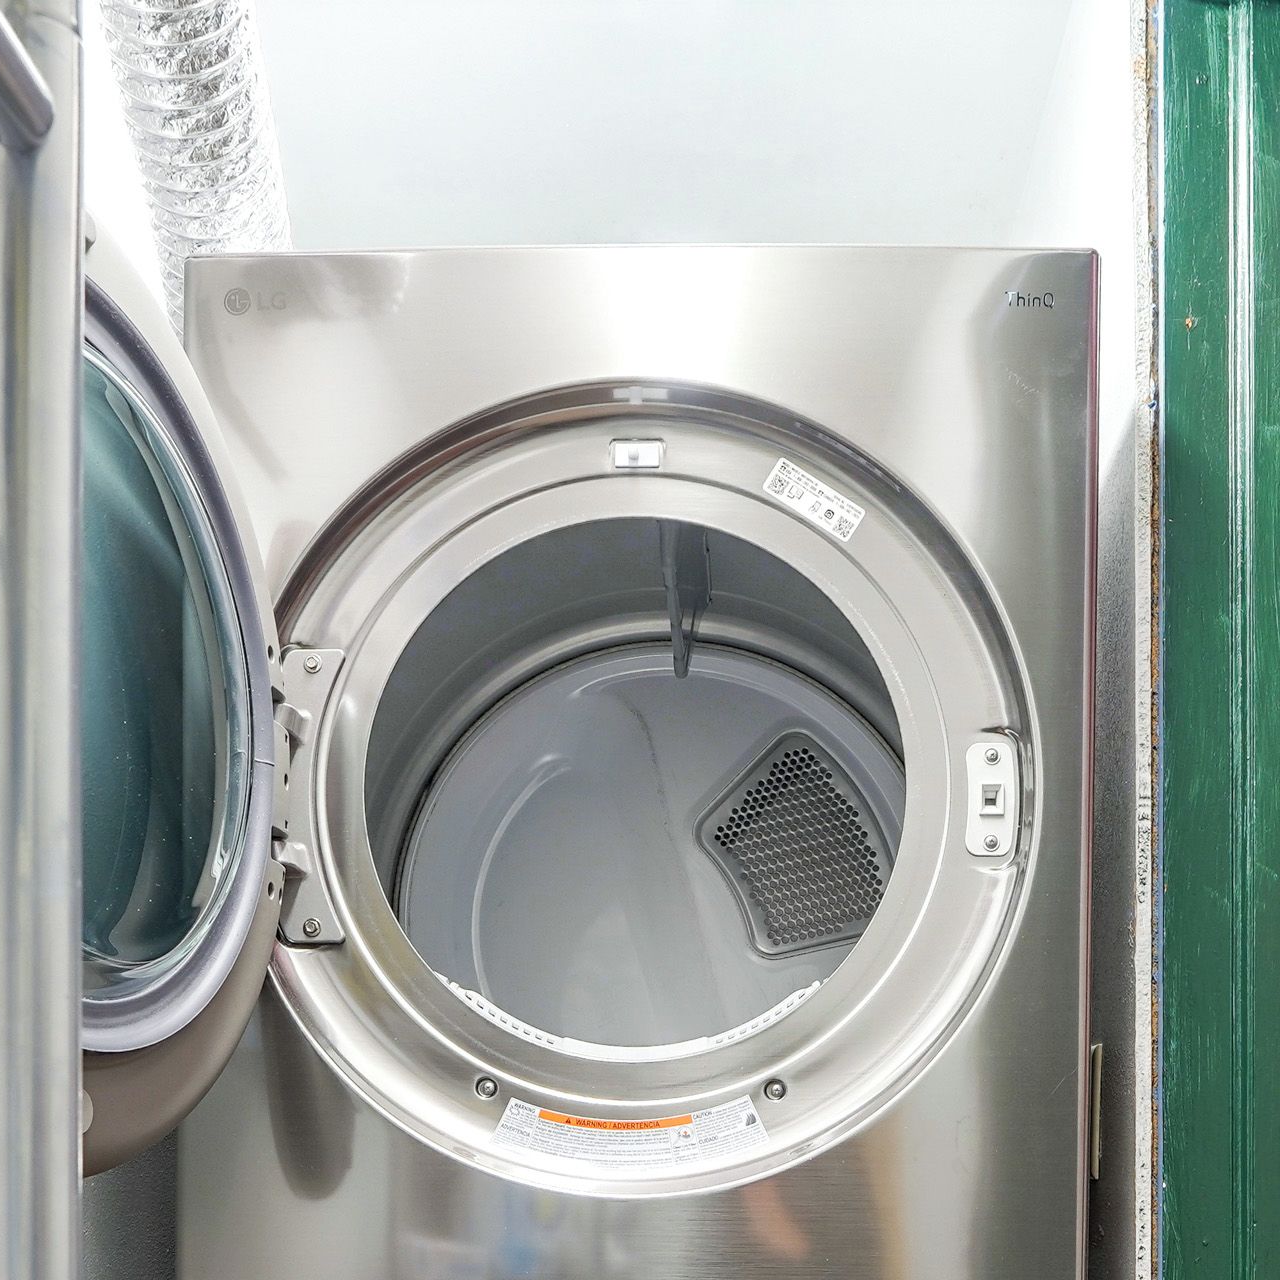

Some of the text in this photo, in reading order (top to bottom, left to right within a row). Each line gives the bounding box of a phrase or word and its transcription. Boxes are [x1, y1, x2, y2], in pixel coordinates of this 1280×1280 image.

[1005, 291, 1055, 309] ThinQ
[514, 1102, 536, 1114] WARNING
[693, 1111, 713, 1120] CAUTION
[500, 1123, 531, 1138] ADVERTENCIA
[576, 1119, 608, 1129] WARNING
[612, 1121, 661, 1130] ADVERTENCIA
